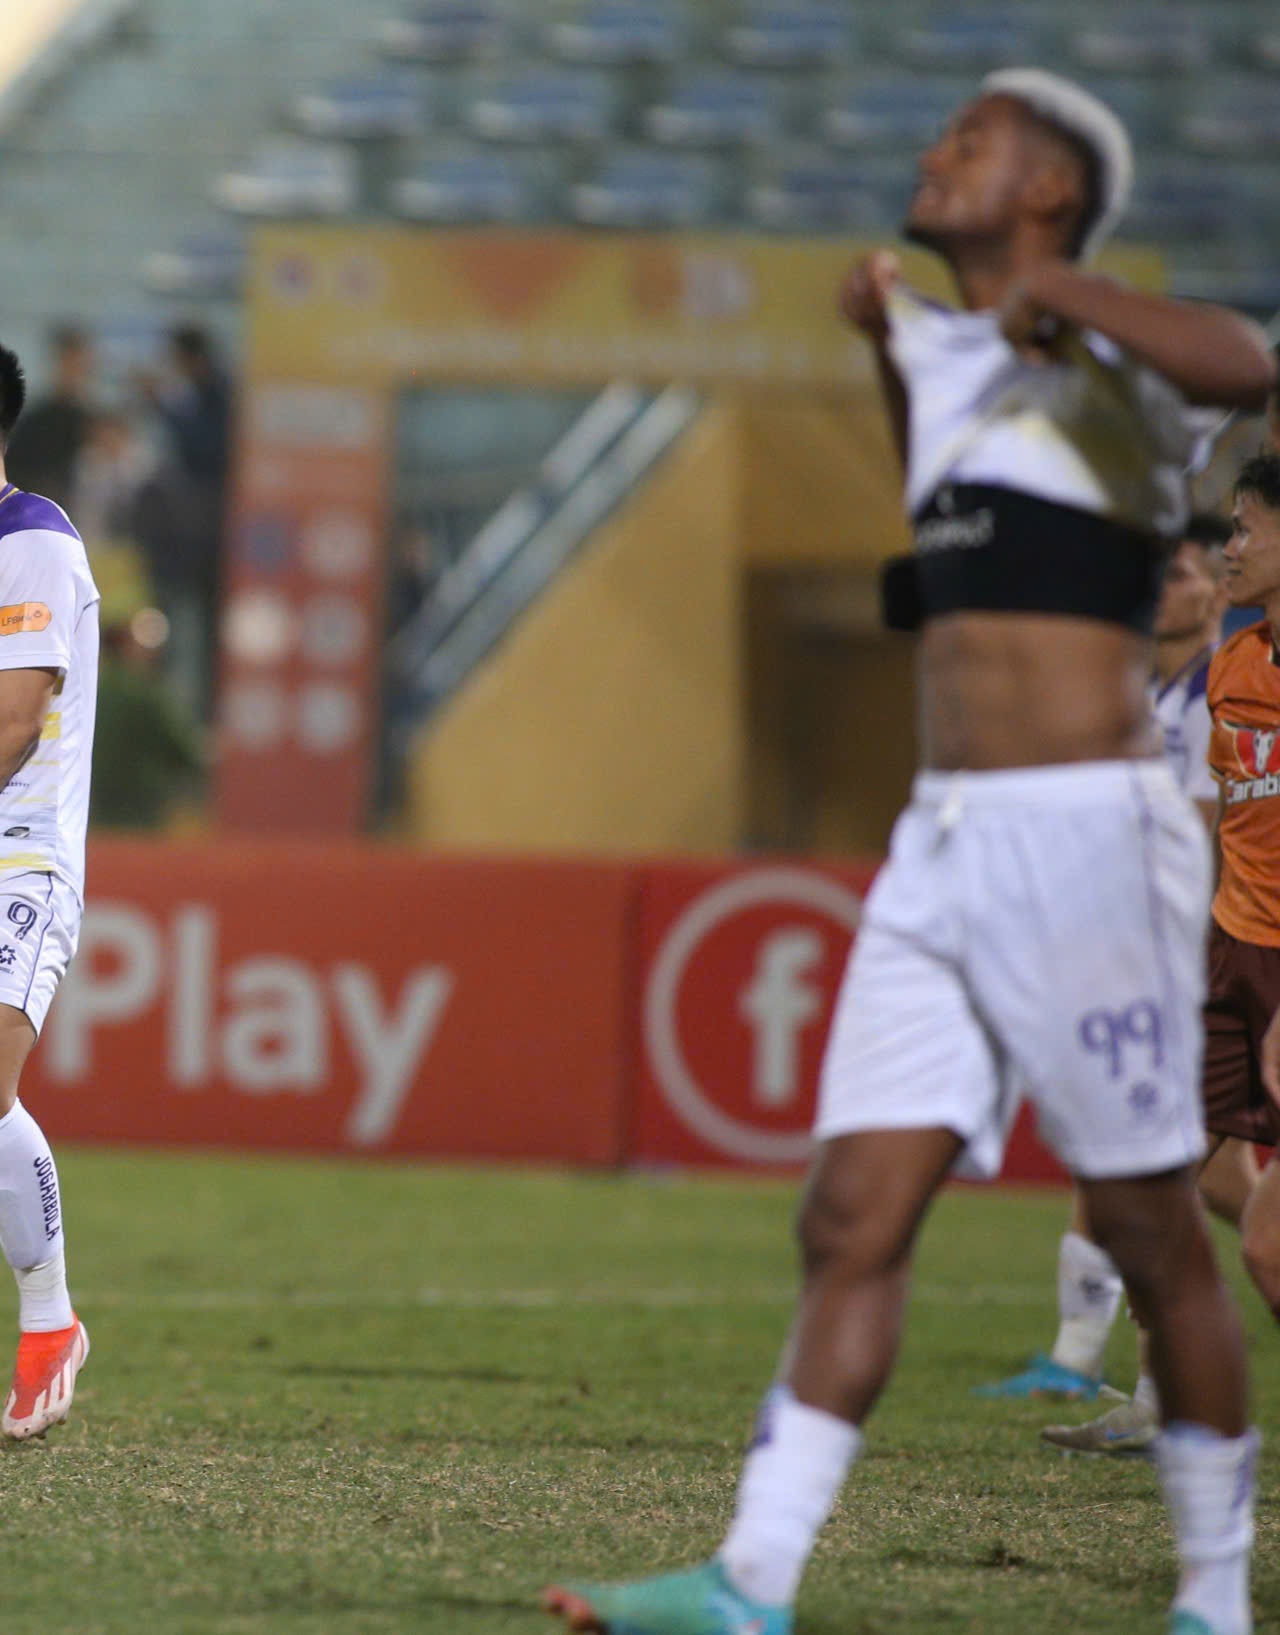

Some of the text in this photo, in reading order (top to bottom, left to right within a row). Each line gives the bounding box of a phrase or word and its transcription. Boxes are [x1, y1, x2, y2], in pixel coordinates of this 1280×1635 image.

[1225, 772, 1280, 806] Carab
[7, 901, 37, 942] 9
[46, 897, 452, 1148] Play
[1079, 999, 1163, 1080] 99
[33, 1155, 61, 1242] JOGARBOLA
